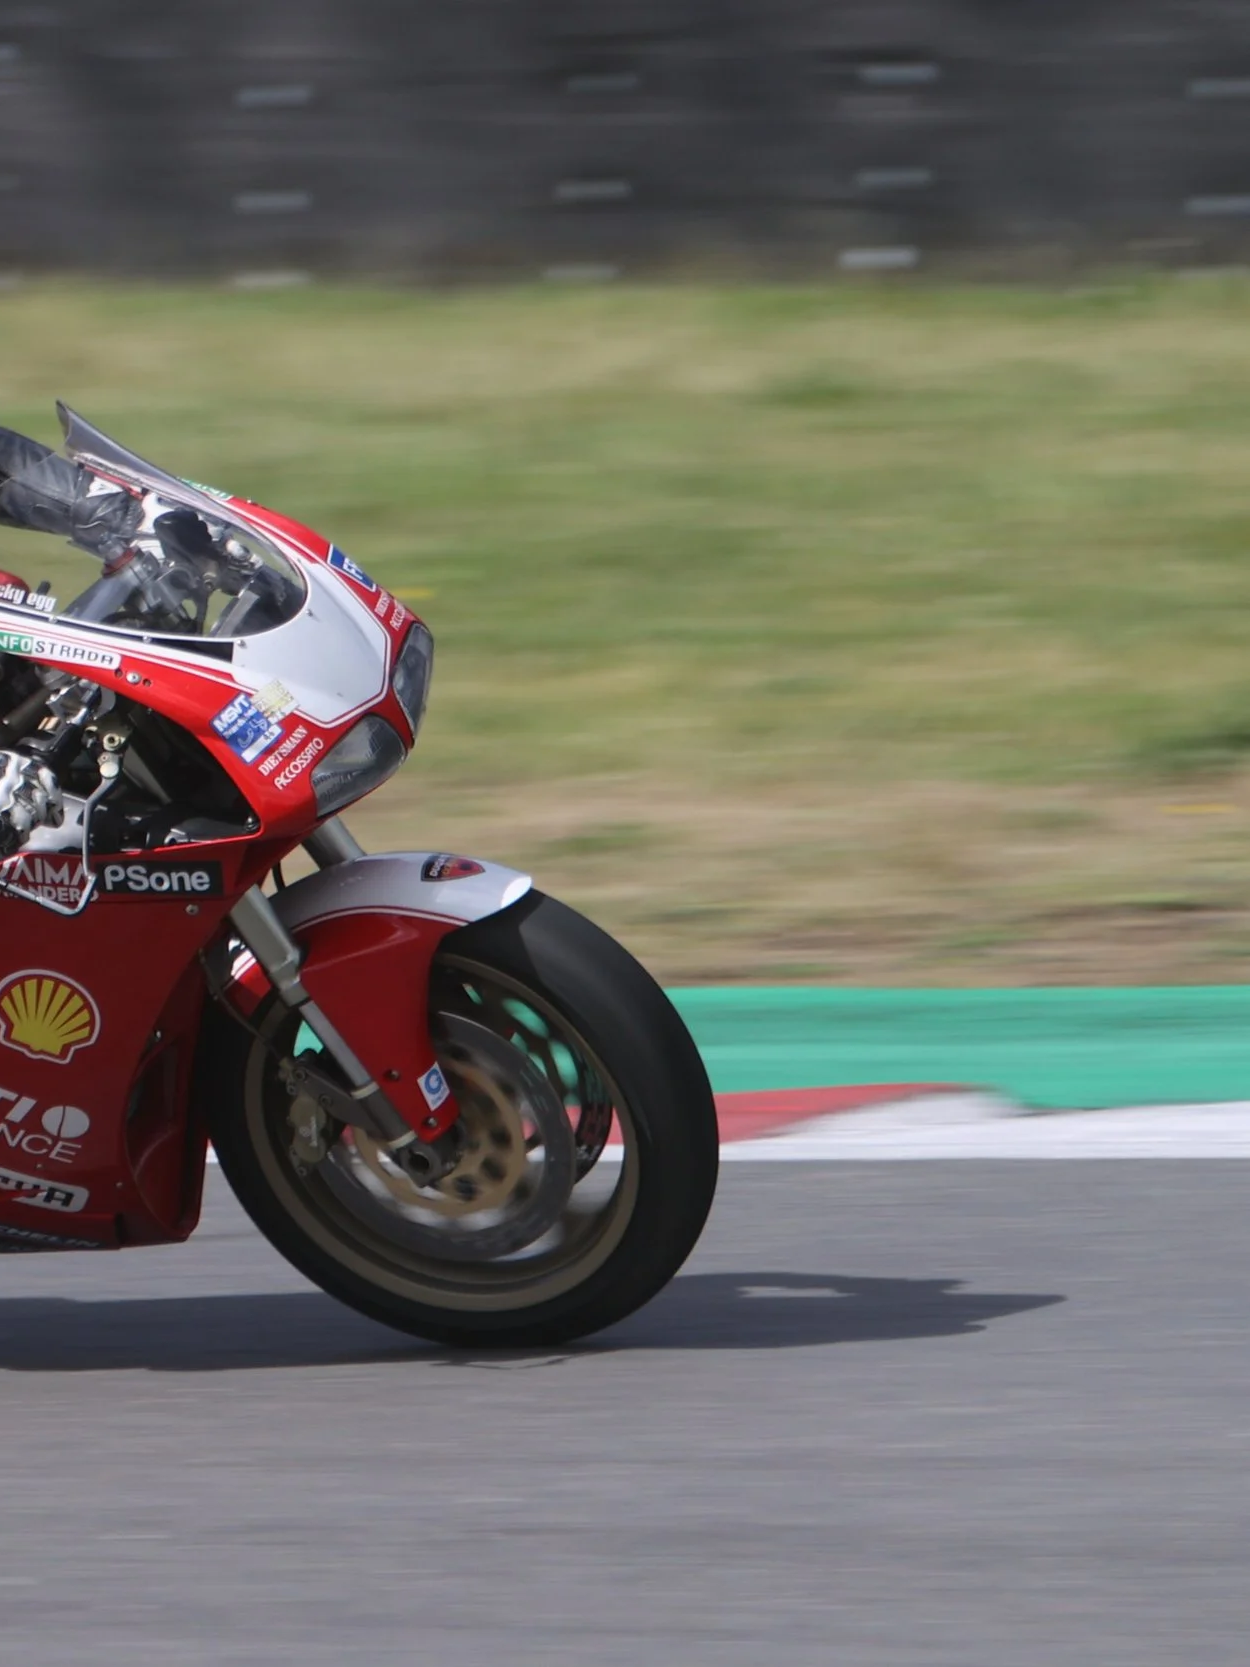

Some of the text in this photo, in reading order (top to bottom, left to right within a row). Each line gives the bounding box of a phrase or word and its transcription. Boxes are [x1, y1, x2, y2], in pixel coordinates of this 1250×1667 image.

[26, 592, 57, 612] egg
[258, 724, 308, 776] DIETSMANN
[274, 737, 324, 790] ACCOSSATO
[104, 864, 211, 892] PSone
